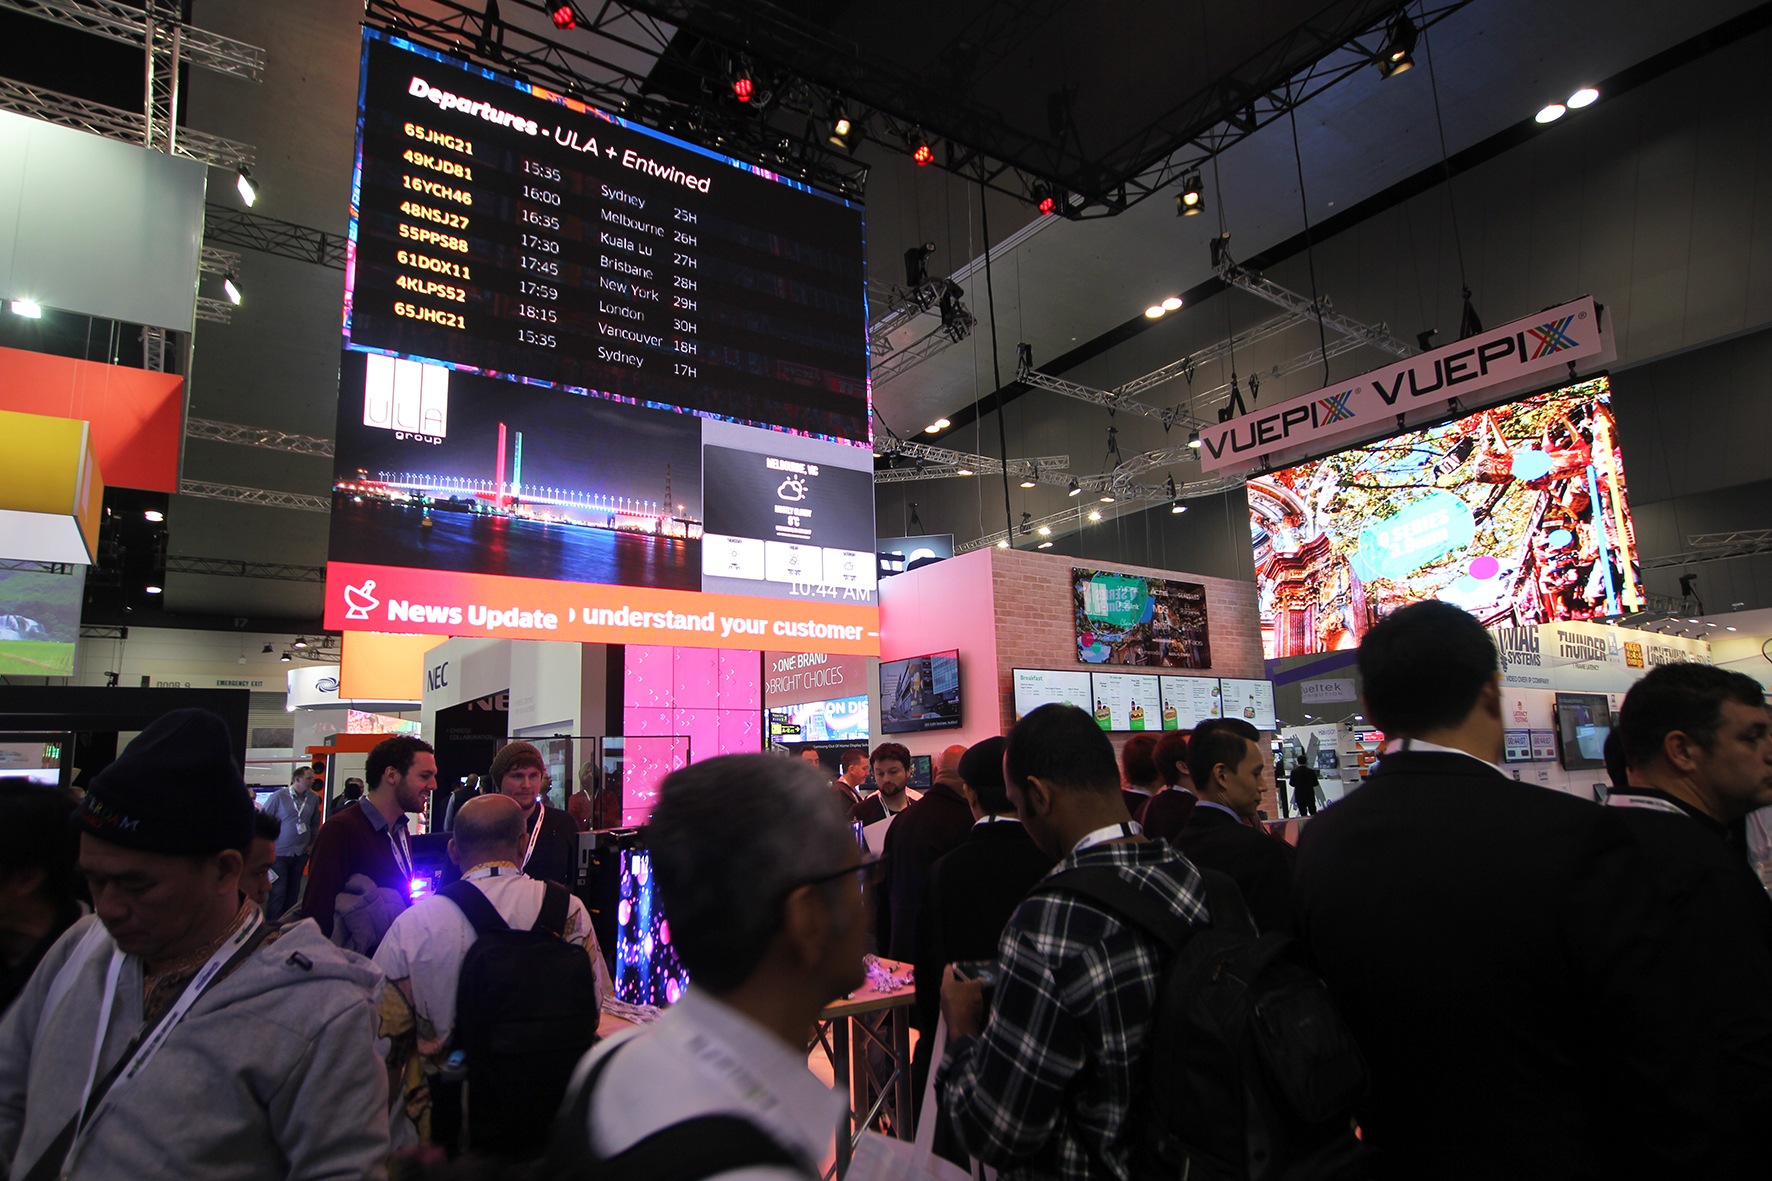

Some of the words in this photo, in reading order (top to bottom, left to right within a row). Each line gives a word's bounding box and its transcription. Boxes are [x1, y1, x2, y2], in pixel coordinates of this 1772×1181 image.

[408, 76, 539, 136] Departures
[554, 126, 599, 157] ULA
[605, 146, 618, 159] +
[622, 149, 711, 193] Entwined
[404, 122, 473, 155] 65JHG21
[524, 161, 561, 182] 15:35
[601, 184, 646, 209] Sydney
[673, 207, 697, 224] 25H
[403, 150, 473, 181] 49KJD81
[523, 185, 561, 206] 16:00
[601, 208, 665, 238] Melbourne
[673, 230, 697, 247] 26H
[403, 175, 473, 206] 16YCH46
[522, 210, 560, 230] 16:35
[600, 231, 634, 252] Kuala
[638, 243, 653, 257] Lu
[673, 252, 697, 269] 27H
[399, 223, 469, 253] 55PPS88
[521, 256, 559, 276] 17:45
[600, 276, 628, 294] New
[631, 283, 659, 302] York
[673, 295, 697, 311] 29H
[400, 201, 470, 230] 48NSJ27
[522, 234, 560, 254] 17:30
[600, 254, 654, 280] Brisbane
[673, 275, 697, 291] 28H
[520, 281, 558, 301] 17:59
[599, 300, 645, 321] London
[673, 318, 697, 334] 30H
[394, 301, 466, 330] 65JHG21
[518, 329, 557, 348] 15:35
[598, 346, 644, 368] Sydney
[673, 363, 697, 379] 17H
[519, 304, 558, 323] 18:15
[598, 321, 664, 347] Vancouver
[673, 339, 697, 355] 18H
[1371, 314, 1581, 406] VUEPIX
[395, 431, 443, 445] group
[1203, 389, 1357, 461] VUEPIX
[1391, 508, 1450, 542] SERIES
[788, 581, 839, 599] 10:44
[842, 586, 871, 602] AM
[387, 599, 463, 625] News
[467, 604, 559, 630] Update
[582, 606, 715, 632] understand
[720, 615, 769, 638] your
[772, 619, 864, 641] customer
[797, 653, 828, 669] BRAND
[1507, 651, 1541, 667] SYSTEMS
[1556, 629, 1607, 662] THUNDER
[427, 661, 449, 693] NEC
[769, 673, 802, 694] BRIGHT
[803, 665, 844, 690] CHOICES
[1506, 675, 1517, 683] VIDEO
[1532, 677, 1550, 685] COMPANY
